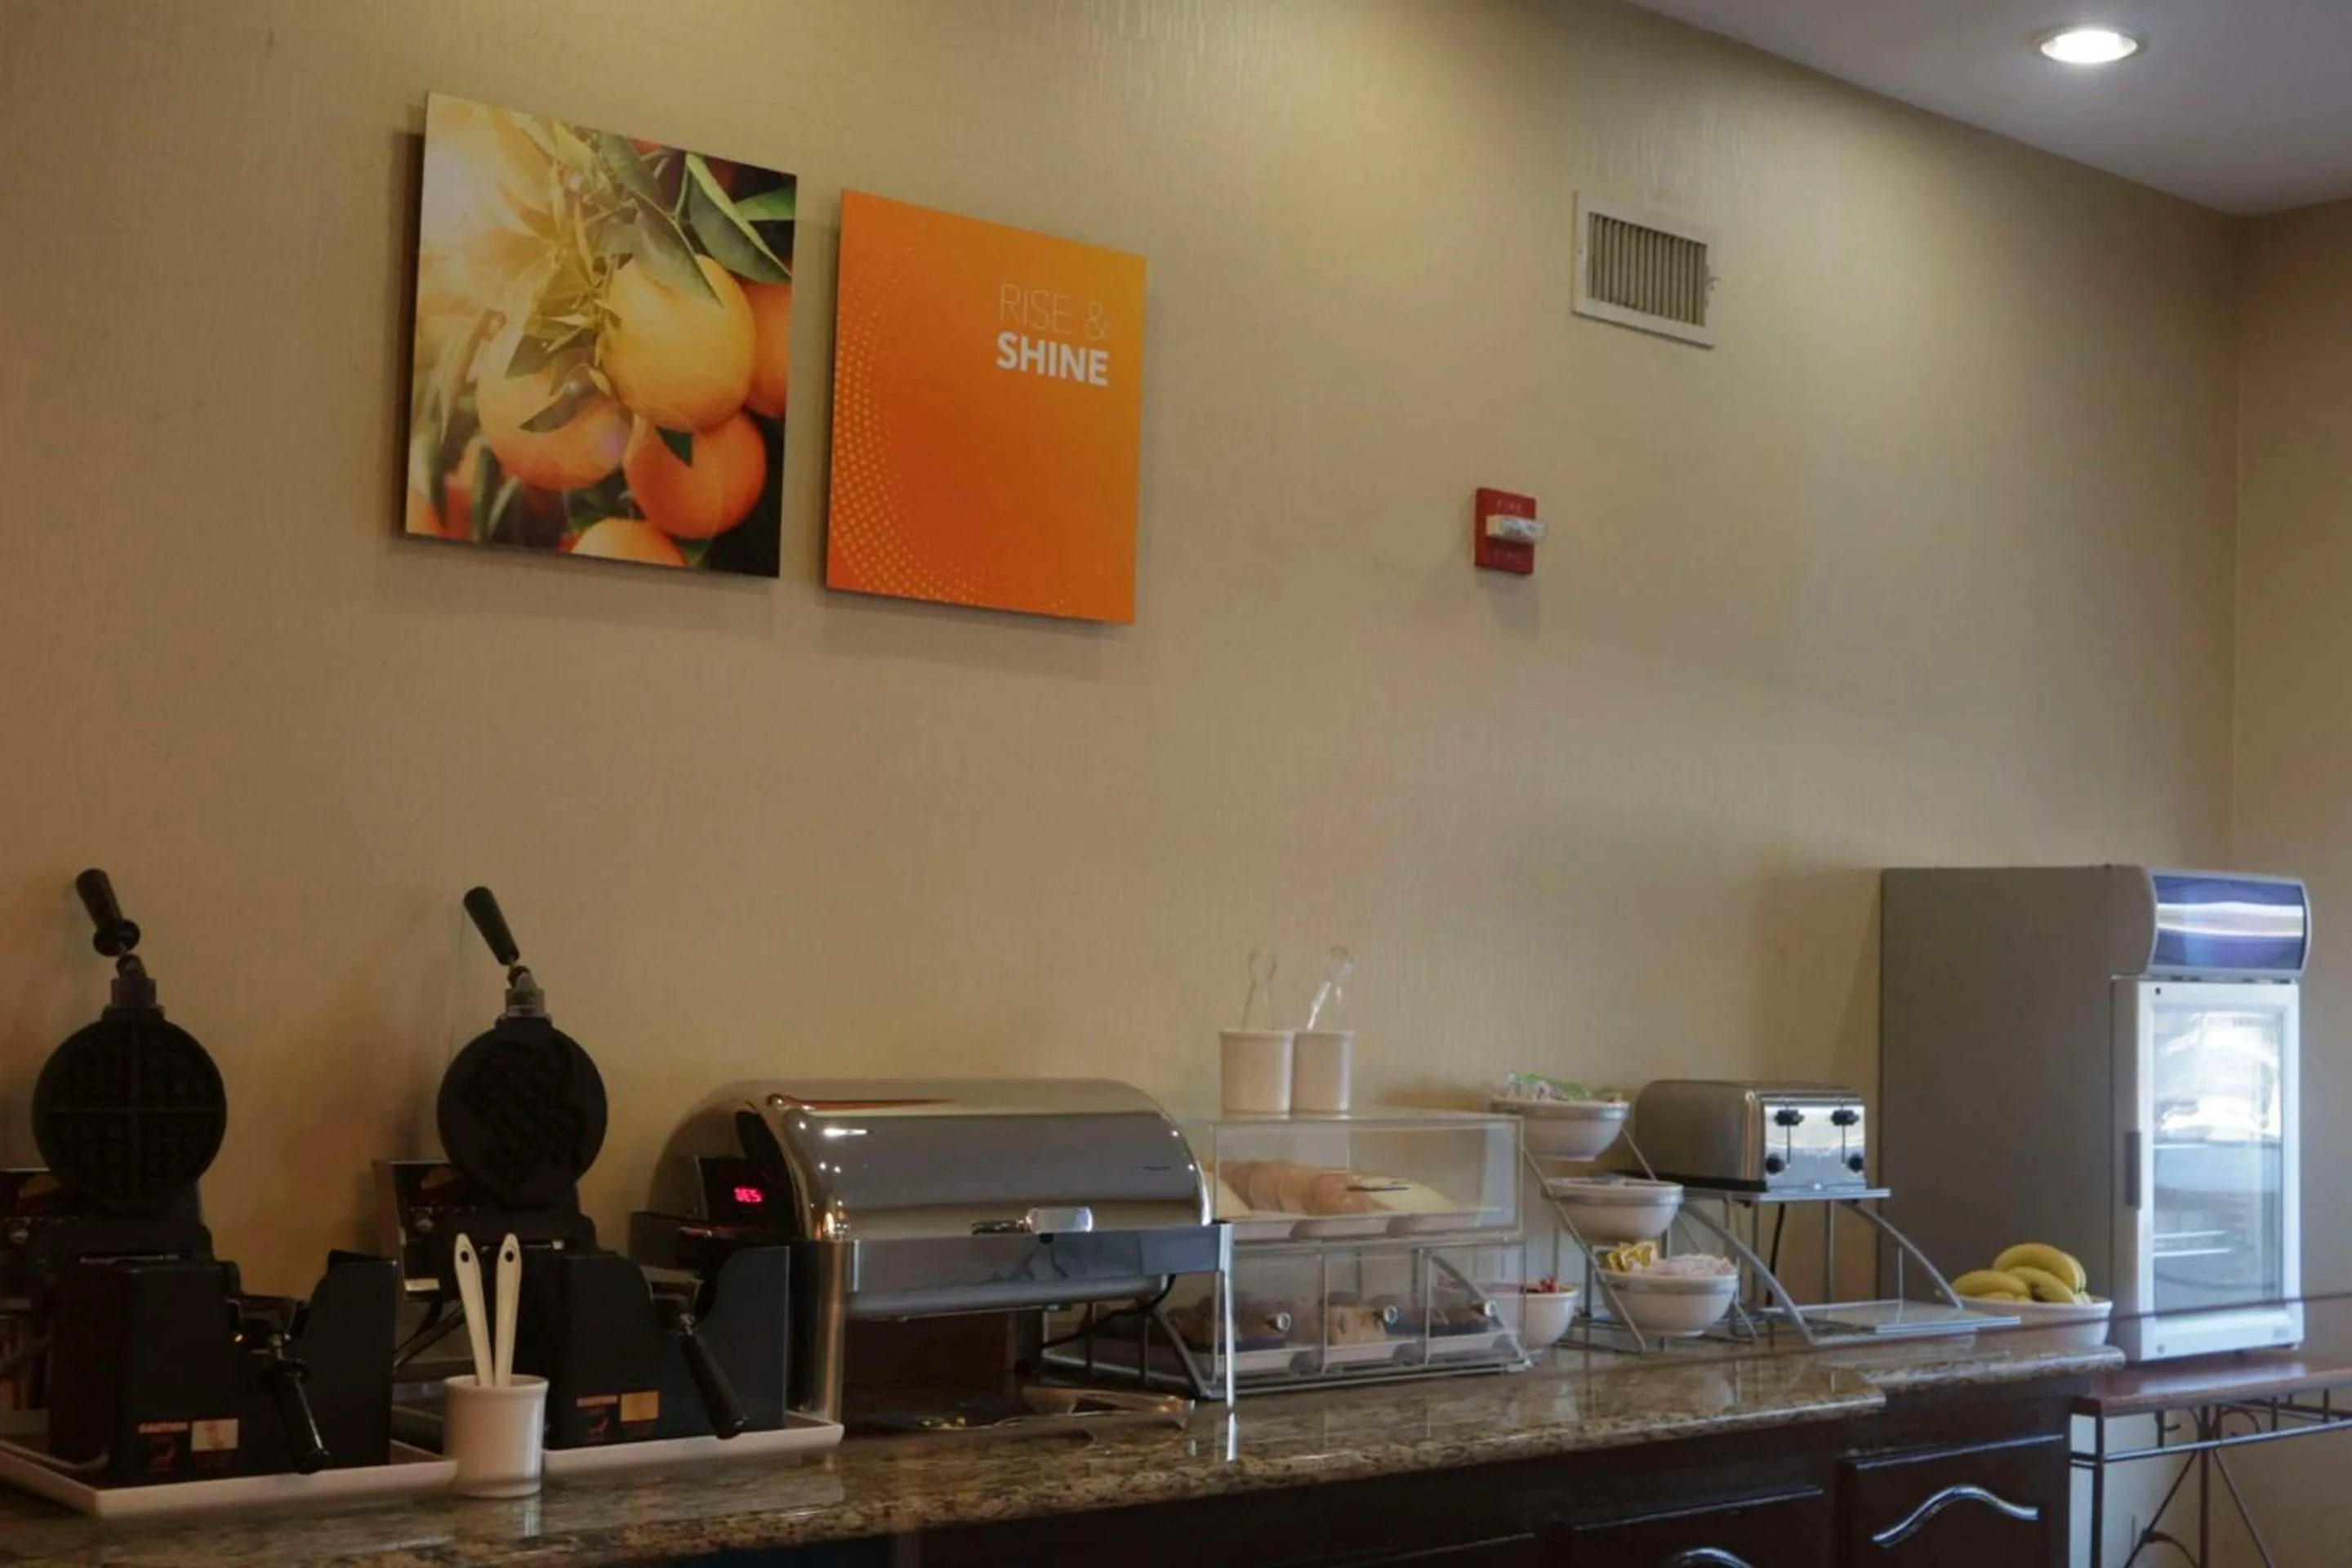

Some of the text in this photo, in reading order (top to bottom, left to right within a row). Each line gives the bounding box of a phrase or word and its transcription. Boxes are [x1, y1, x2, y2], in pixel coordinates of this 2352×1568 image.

[1000, 281, 1108, 341] RISE &
[996, 331, 1109, 387] SHINE
